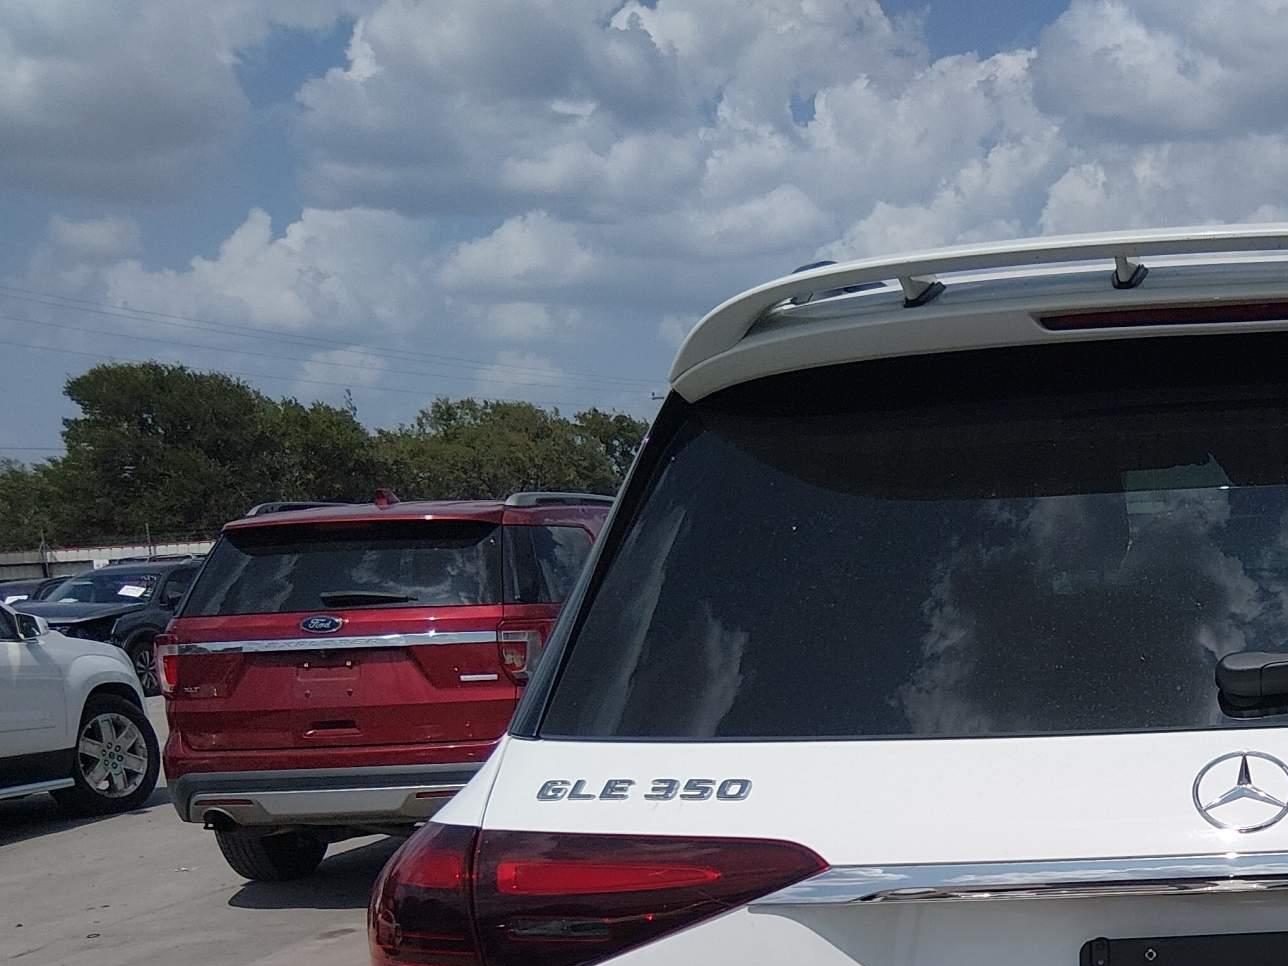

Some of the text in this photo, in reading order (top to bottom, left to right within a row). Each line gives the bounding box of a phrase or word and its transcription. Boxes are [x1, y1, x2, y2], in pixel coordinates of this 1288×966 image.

[308, 618, 331, 630] Ford
[536, 778, 753, 802] GLE 350
